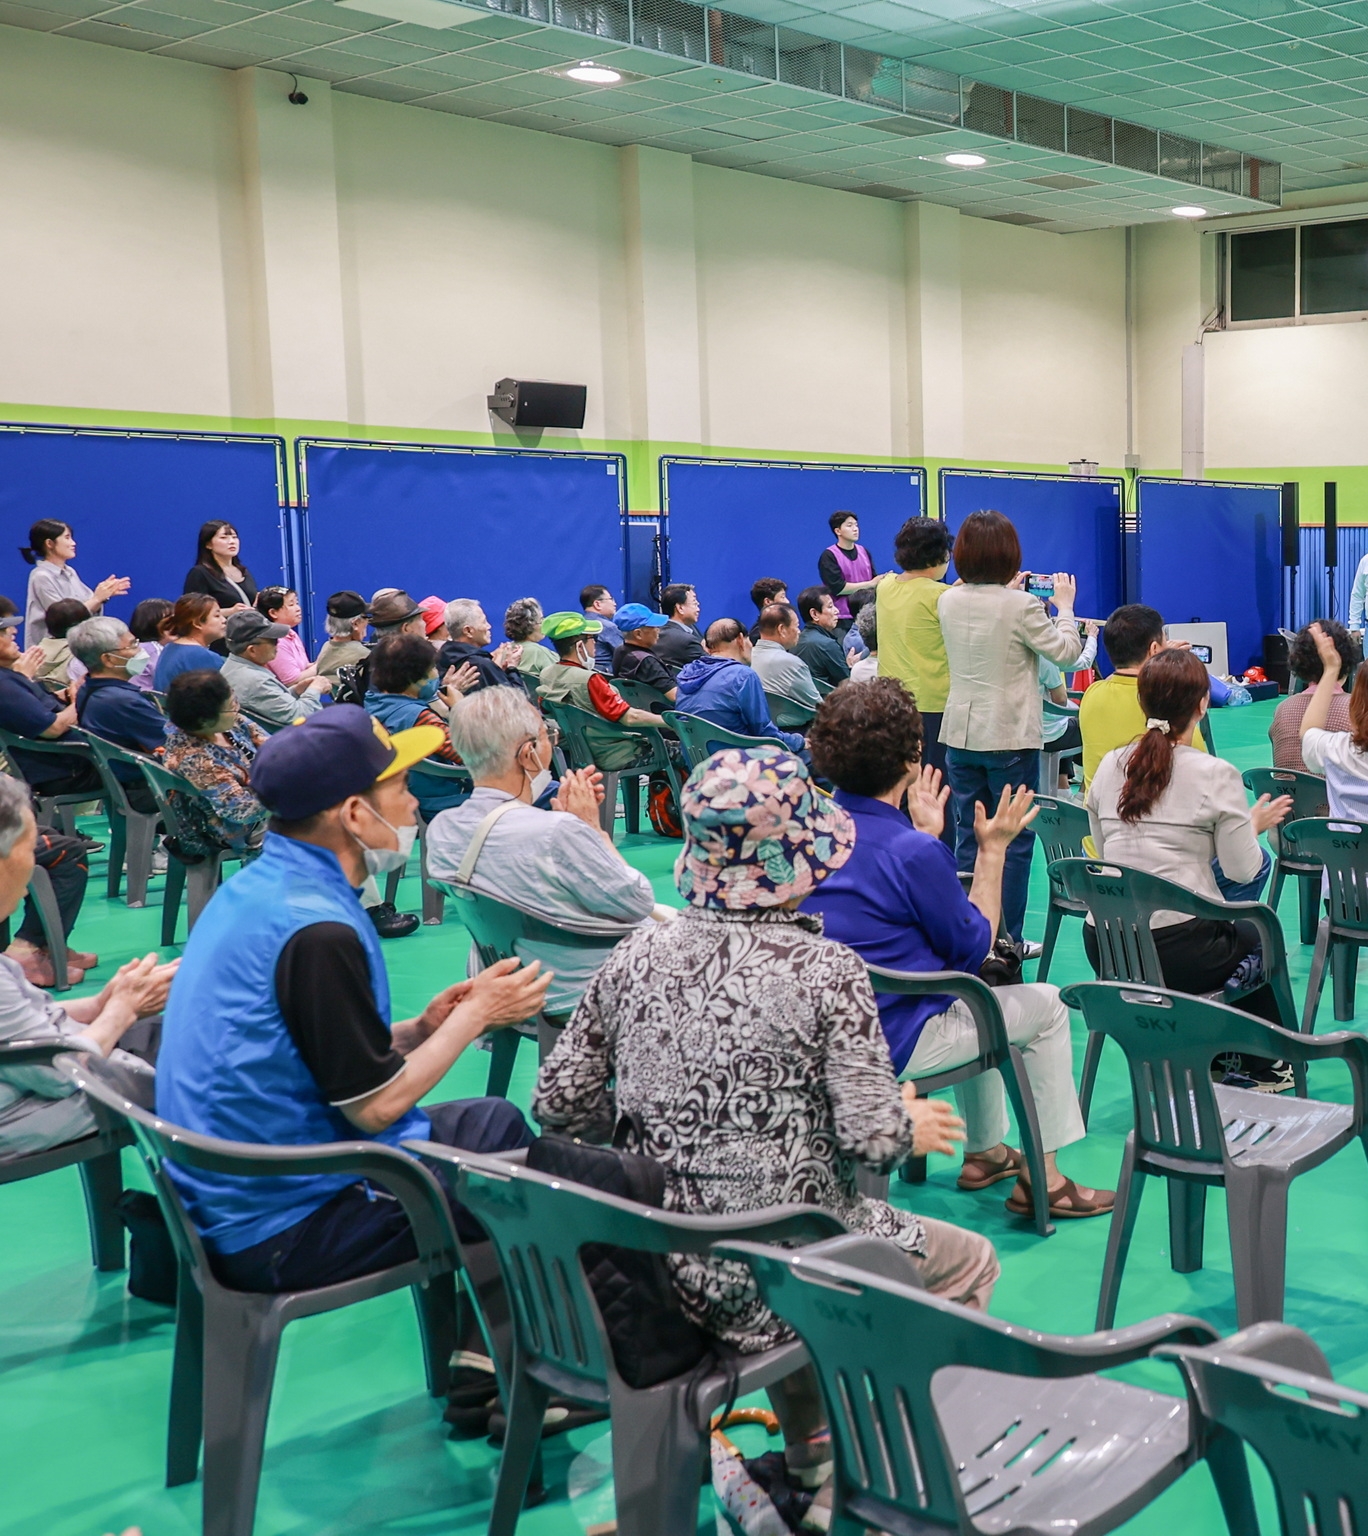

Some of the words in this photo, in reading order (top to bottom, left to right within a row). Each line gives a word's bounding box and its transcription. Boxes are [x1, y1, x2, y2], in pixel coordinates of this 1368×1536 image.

[1275, 785, 1297, 795] SKY
[1040, 815, 1061, 826] SKY
[1332, 839, 1360, 850] SKY
[1096, 884, 1125, 897] SKY
[1135, 1015, 1177, 1033] SKY
[814, 1299, 873, 1332] SKY
[1284, 1414, 1362, 1456] SKY
